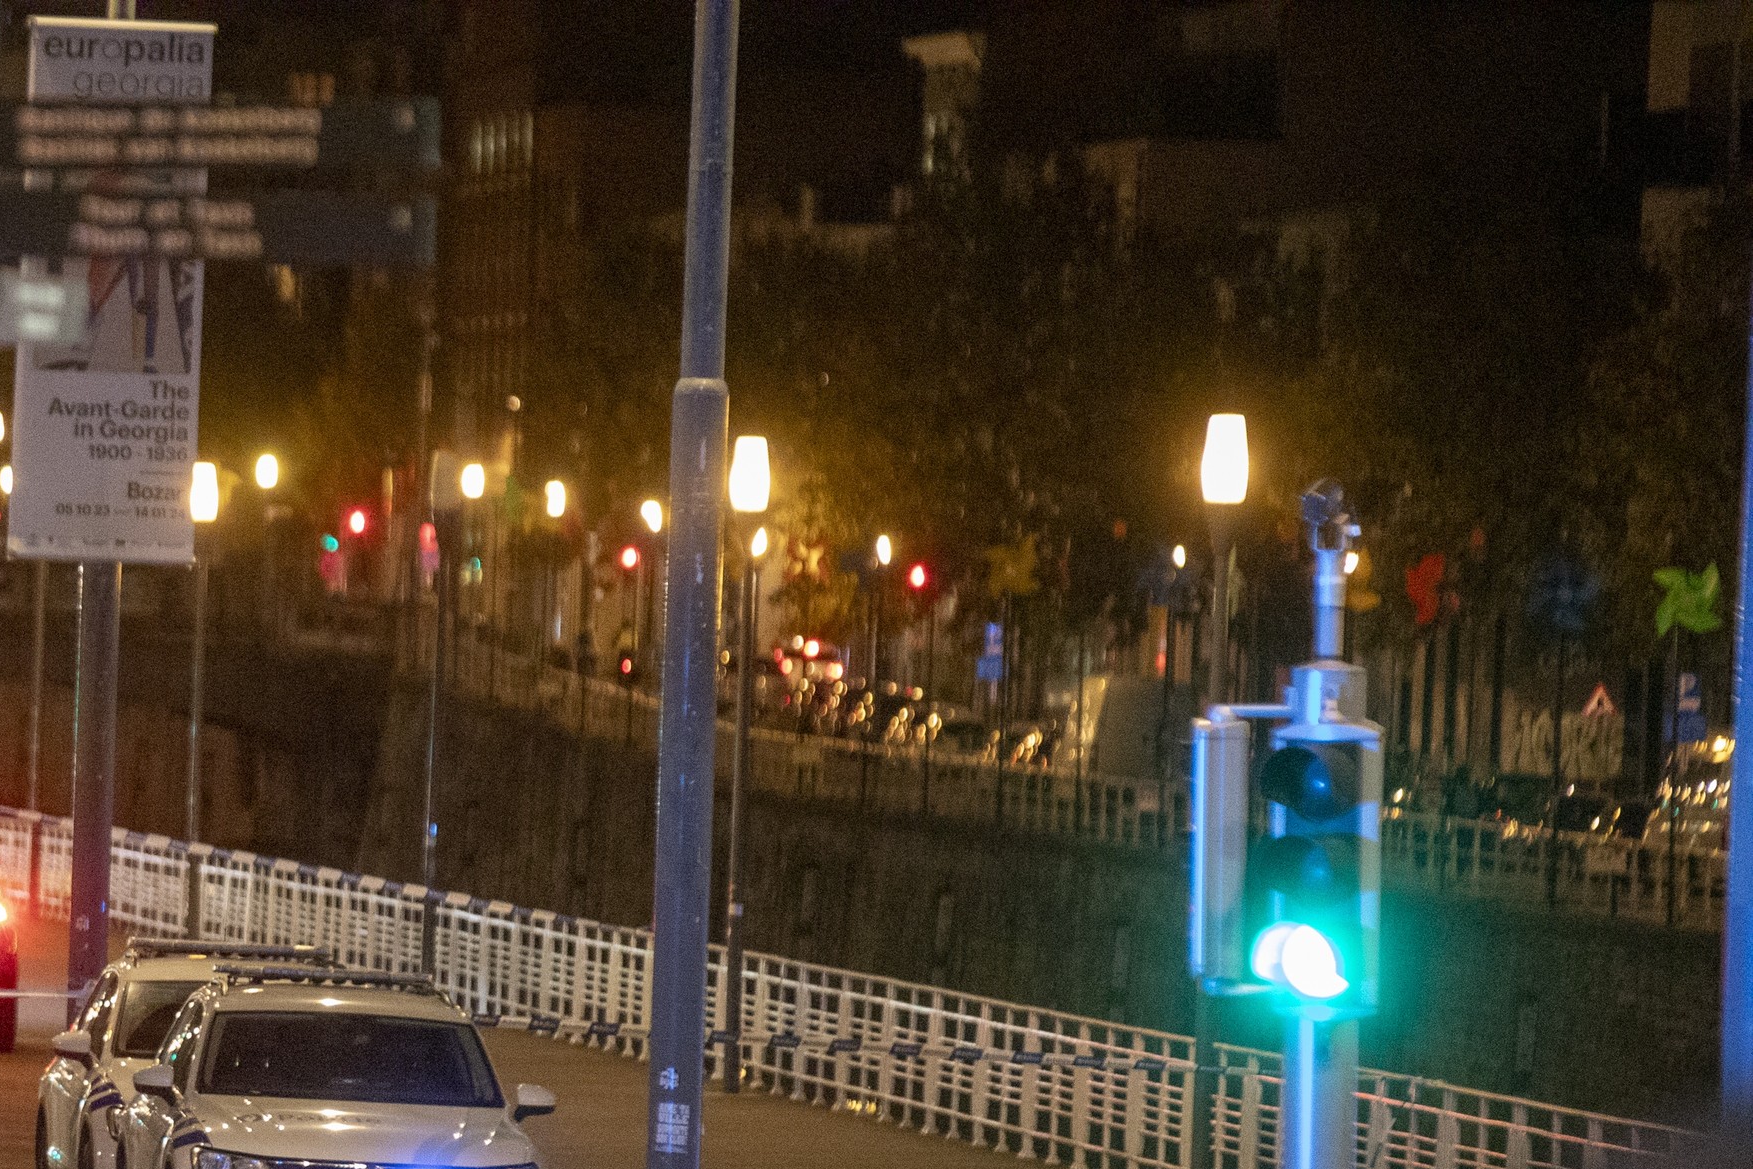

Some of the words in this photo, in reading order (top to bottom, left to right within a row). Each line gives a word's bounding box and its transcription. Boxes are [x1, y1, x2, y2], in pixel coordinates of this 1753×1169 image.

[43, 34, 205, 65] europalia
[73, 70, 204, 98] georgia
[151, 380, 190, 401] The
[48, 397, 190, 421] Avant-Garde
[74, 420, 94, 439] in
[99, 421, 188, 444] Georgia
[89, 444, 133, 461] 1900
[126, 481, 182, 501] Bozar
